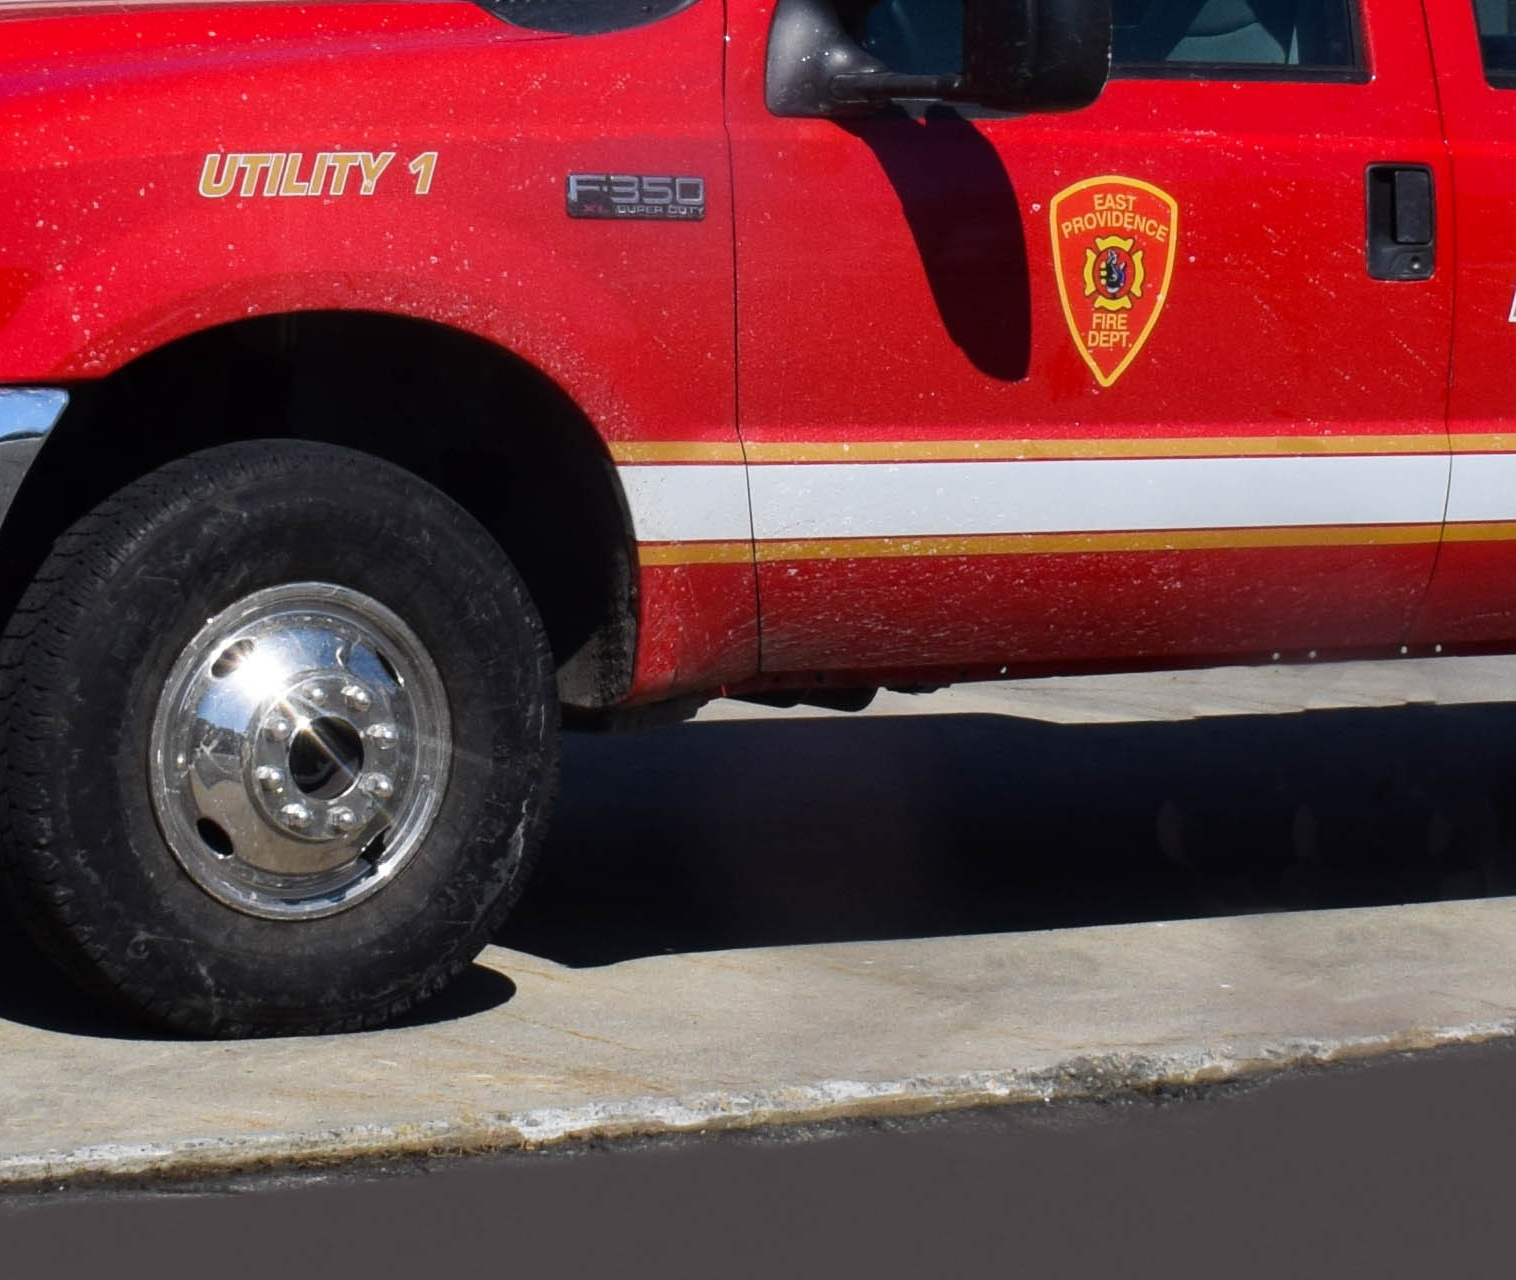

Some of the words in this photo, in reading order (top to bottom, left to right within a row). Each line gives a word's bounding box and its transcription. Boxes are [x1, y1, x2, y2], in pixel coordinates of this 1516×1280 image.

[199, 152, 396, 198] UTILITY
[409, 152, 438, 195] 1
[616, 205, 664, 214] SUPER
[668, 205, 705, 215] DUTY
[1093, 193, 1136, 211] EAST
[1061, 211, 1169, 243] PROVIDENCE
[1092, 313, 1128, 330] FIRE
[1087, 331, 1133, 348] DEPT.
